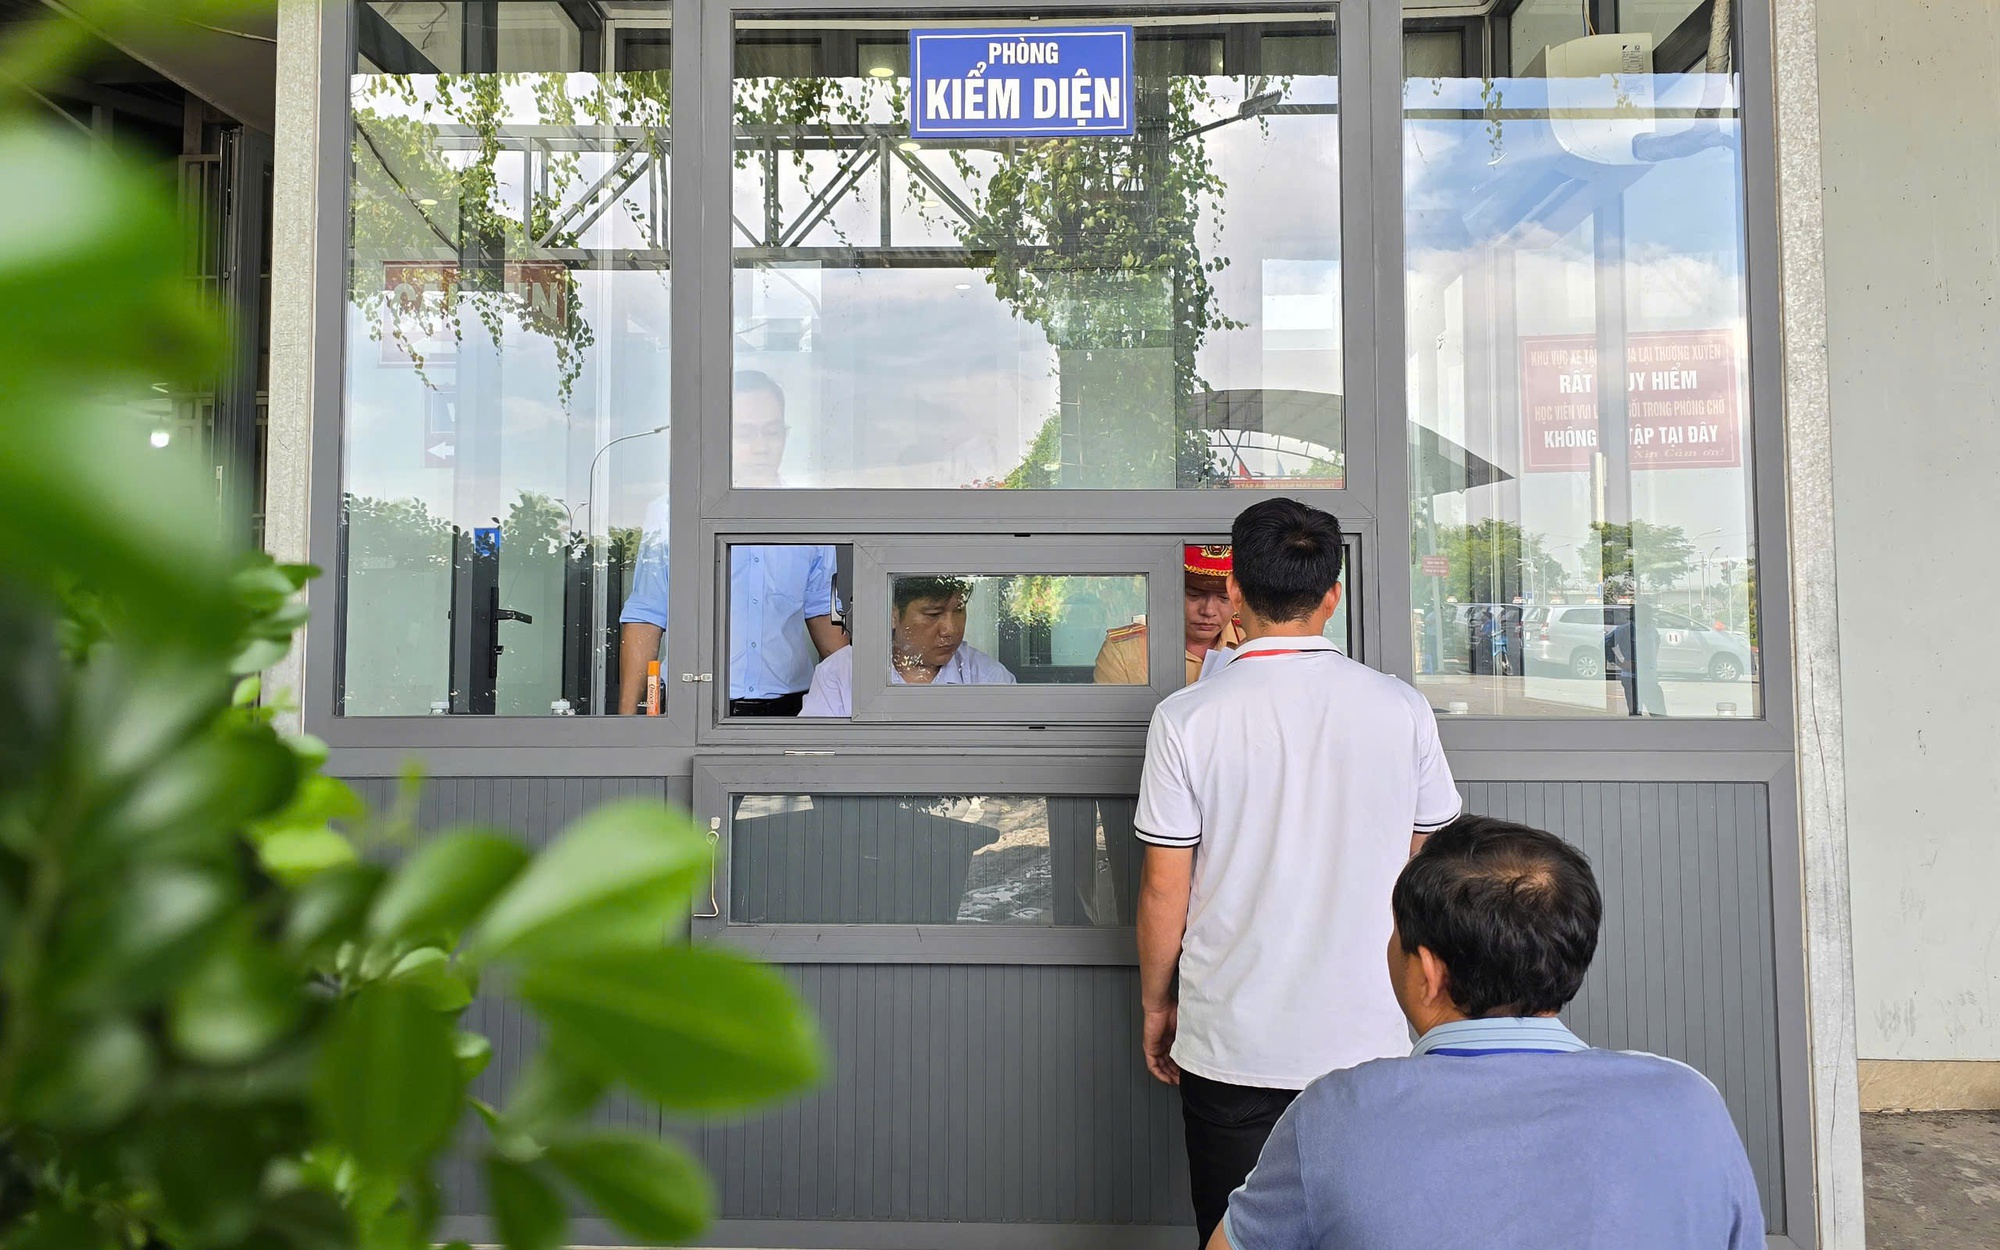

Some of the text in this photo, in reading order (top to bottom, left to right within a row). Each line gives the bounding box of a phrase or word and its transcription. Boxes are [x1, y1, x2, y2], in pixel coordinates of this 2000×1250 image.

[988, 37, 1059, 64] PHÒNG
[926, 62, 1120, 126] KIỂM DIỆN
[1570, 349, 1582, 365] XE
[1638, 346, 1652, 365] LẠI
[1654, 342, 1689, 362] THƯỜNG
[1691, 341, 1721, 360] XUYÊN
[1559, 368, 1593, 393] RẤT
[1652, 362, 1698, 391] HIỂM
[1534, 405, 1553, 424] HỌC
[1554, 402, 1575, 420] VIÊN
[1576, 403, 1591, 420] VUI
[1643, 400, 1672, 418] TRONG
[1674, 397, 1705, 416] PHÒNG
[1544, 425, 1597, 448] KHÔNG
[1659, 425, 1683, 447] TẠI
[1687, 421, 1718, 443] ĐÂY
[1634, 449, 1658, 458] Xin
